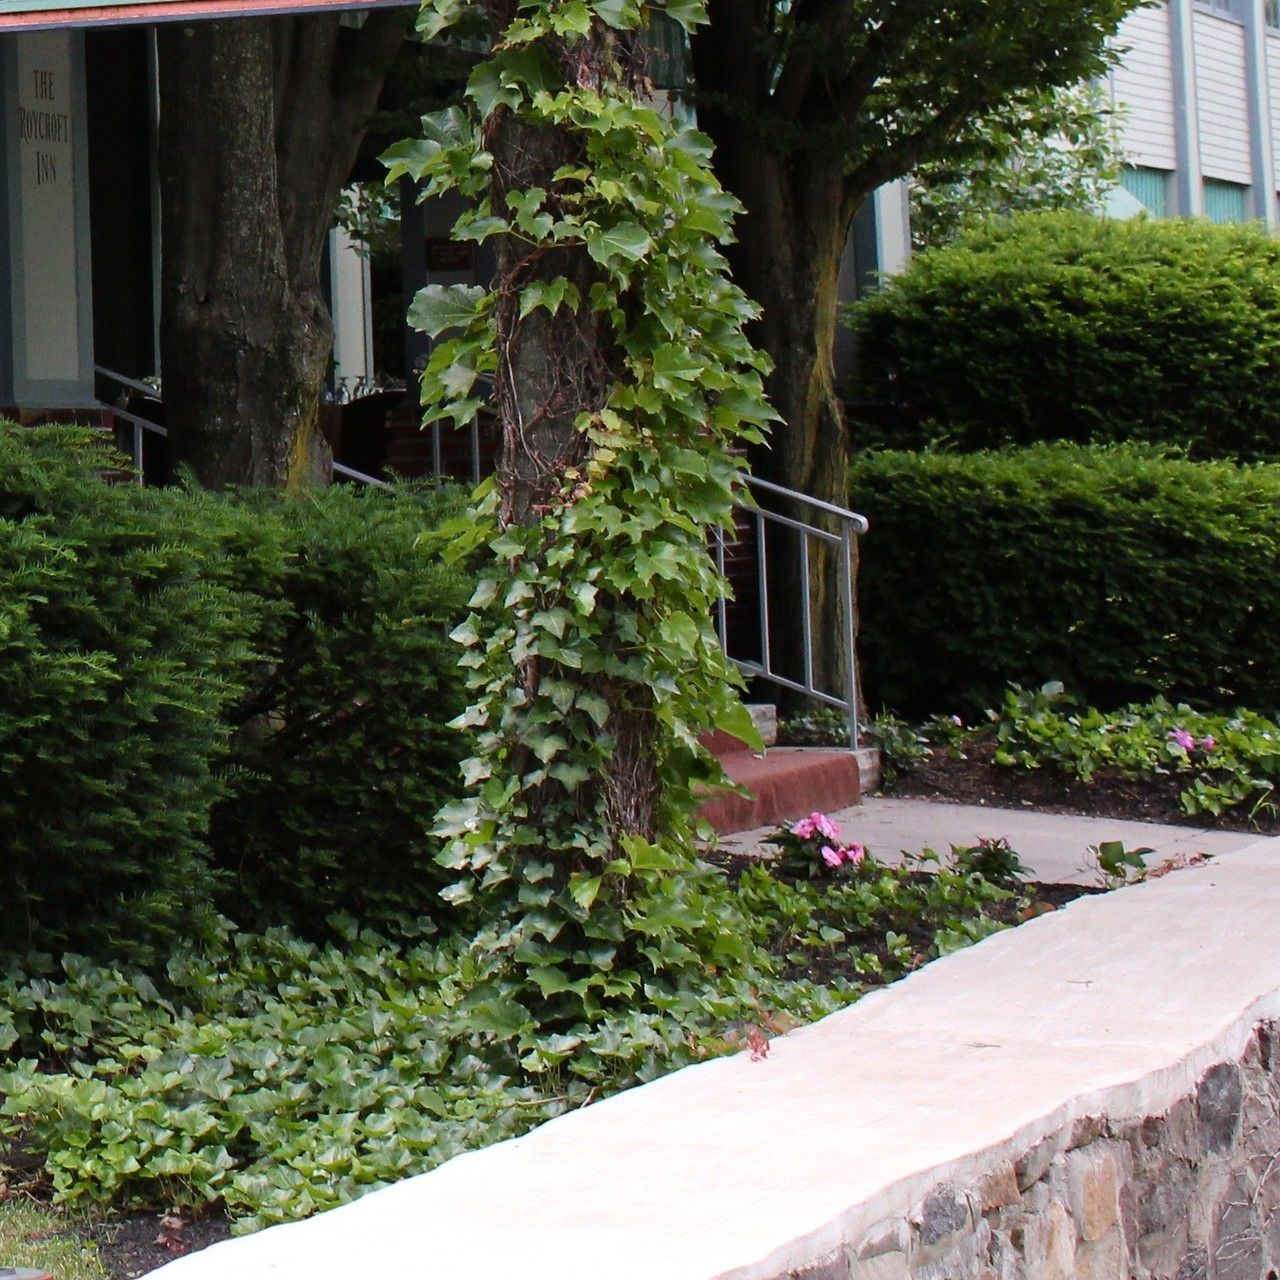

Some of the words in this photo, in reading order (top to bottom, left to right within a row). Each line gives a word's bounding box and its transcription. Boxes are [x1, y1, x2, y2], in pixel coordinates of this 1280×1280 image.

[32, 69, 56, 101] THE
[19, 106, 69, 145] ROYCROFT
[36, 150, 57, 185] INN
